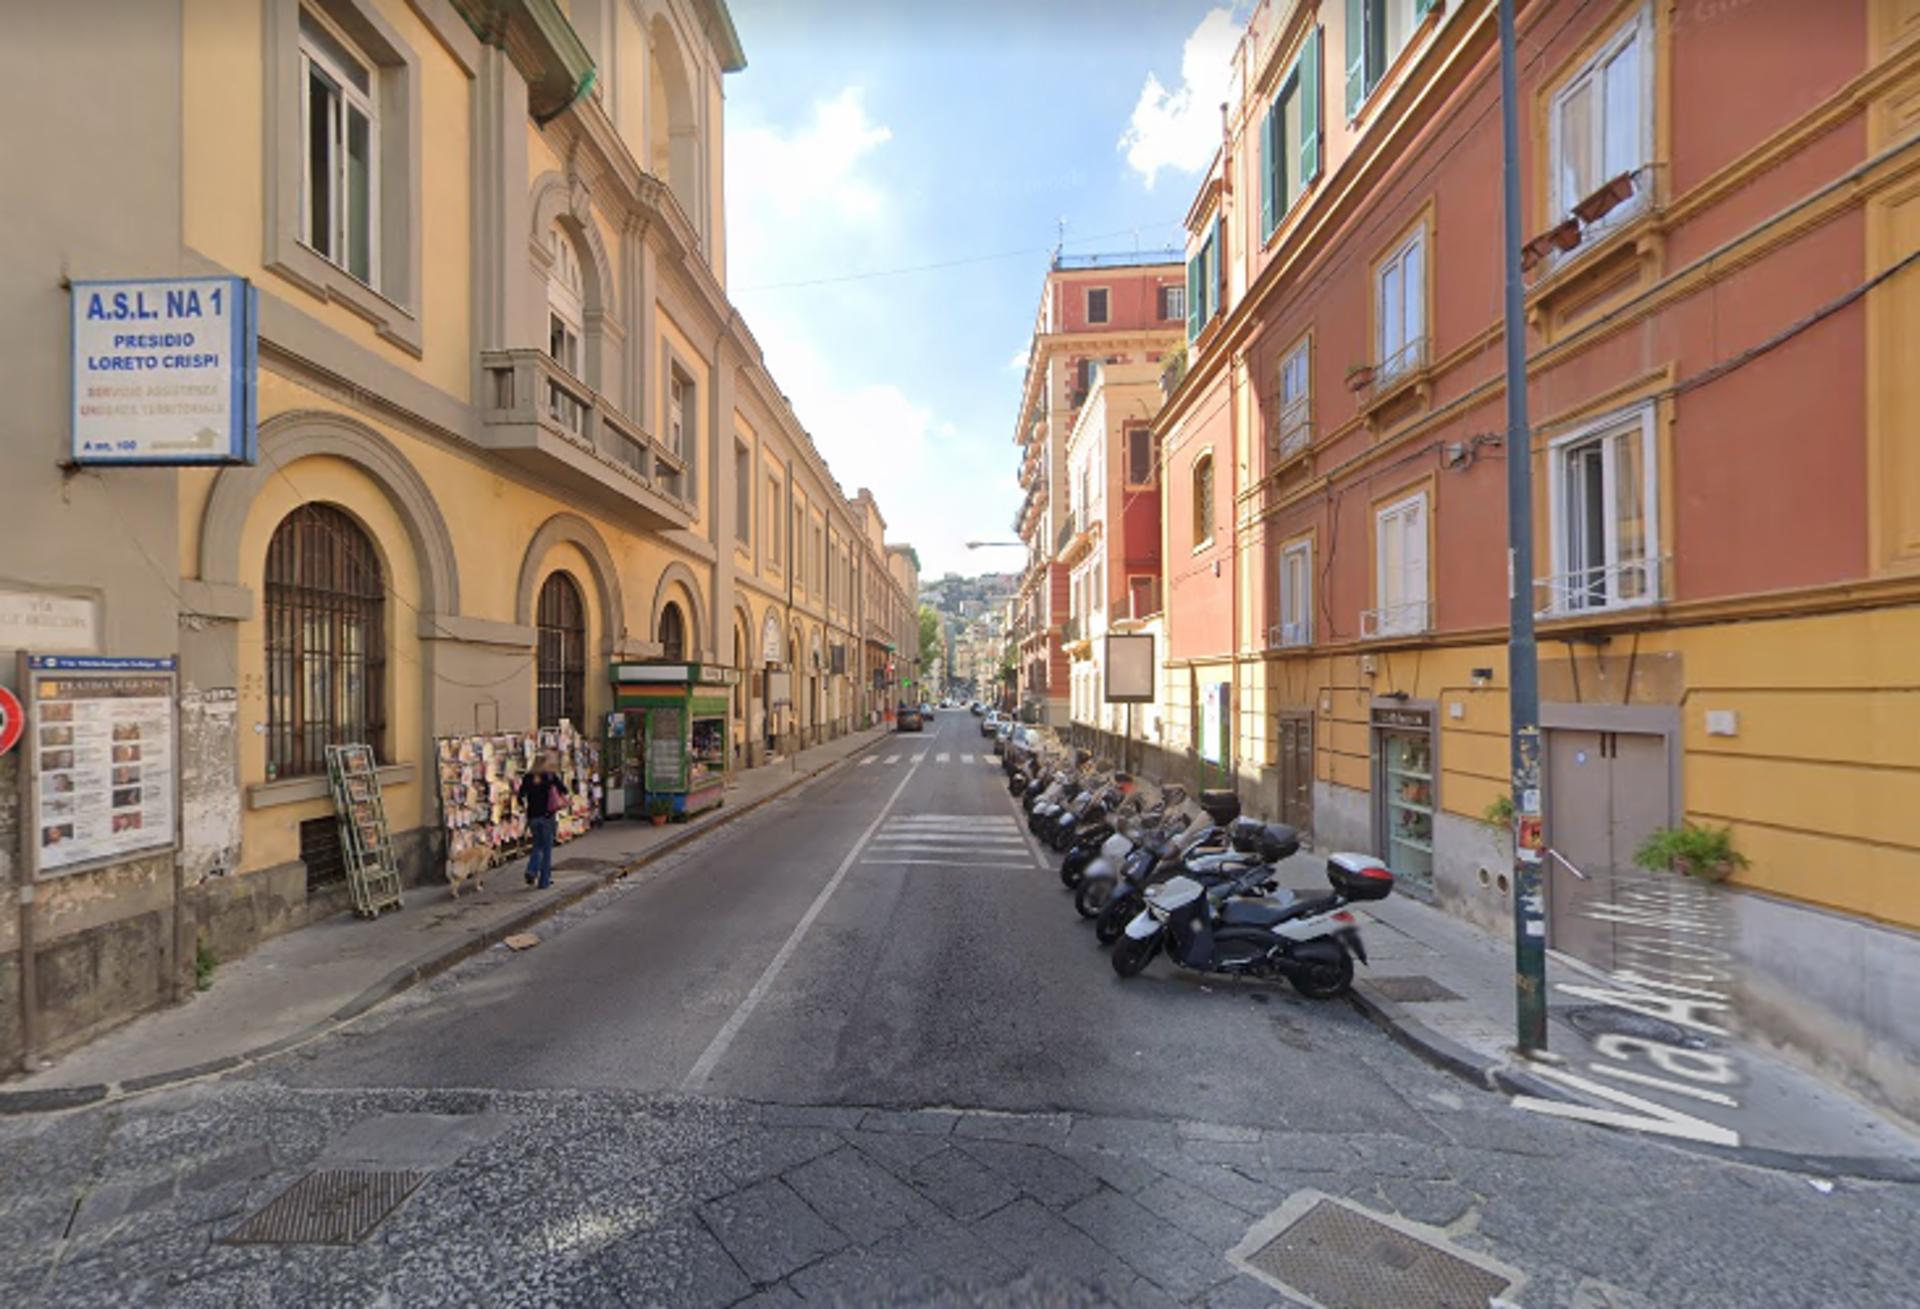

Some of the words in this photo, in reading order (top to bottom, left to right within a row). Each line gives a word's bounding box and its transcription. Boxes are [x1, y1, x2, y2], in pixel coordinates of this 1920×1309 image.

[87, 291, 159, 320] A.S.L.
[167, 289, 202, 318] NA
[210, 287, 222, 316] 1
[114, 332, 195, 348] PRESIDIO
[88, 355, 158, 371] LORETO
[162, 353, 219, 369] CRISPI
